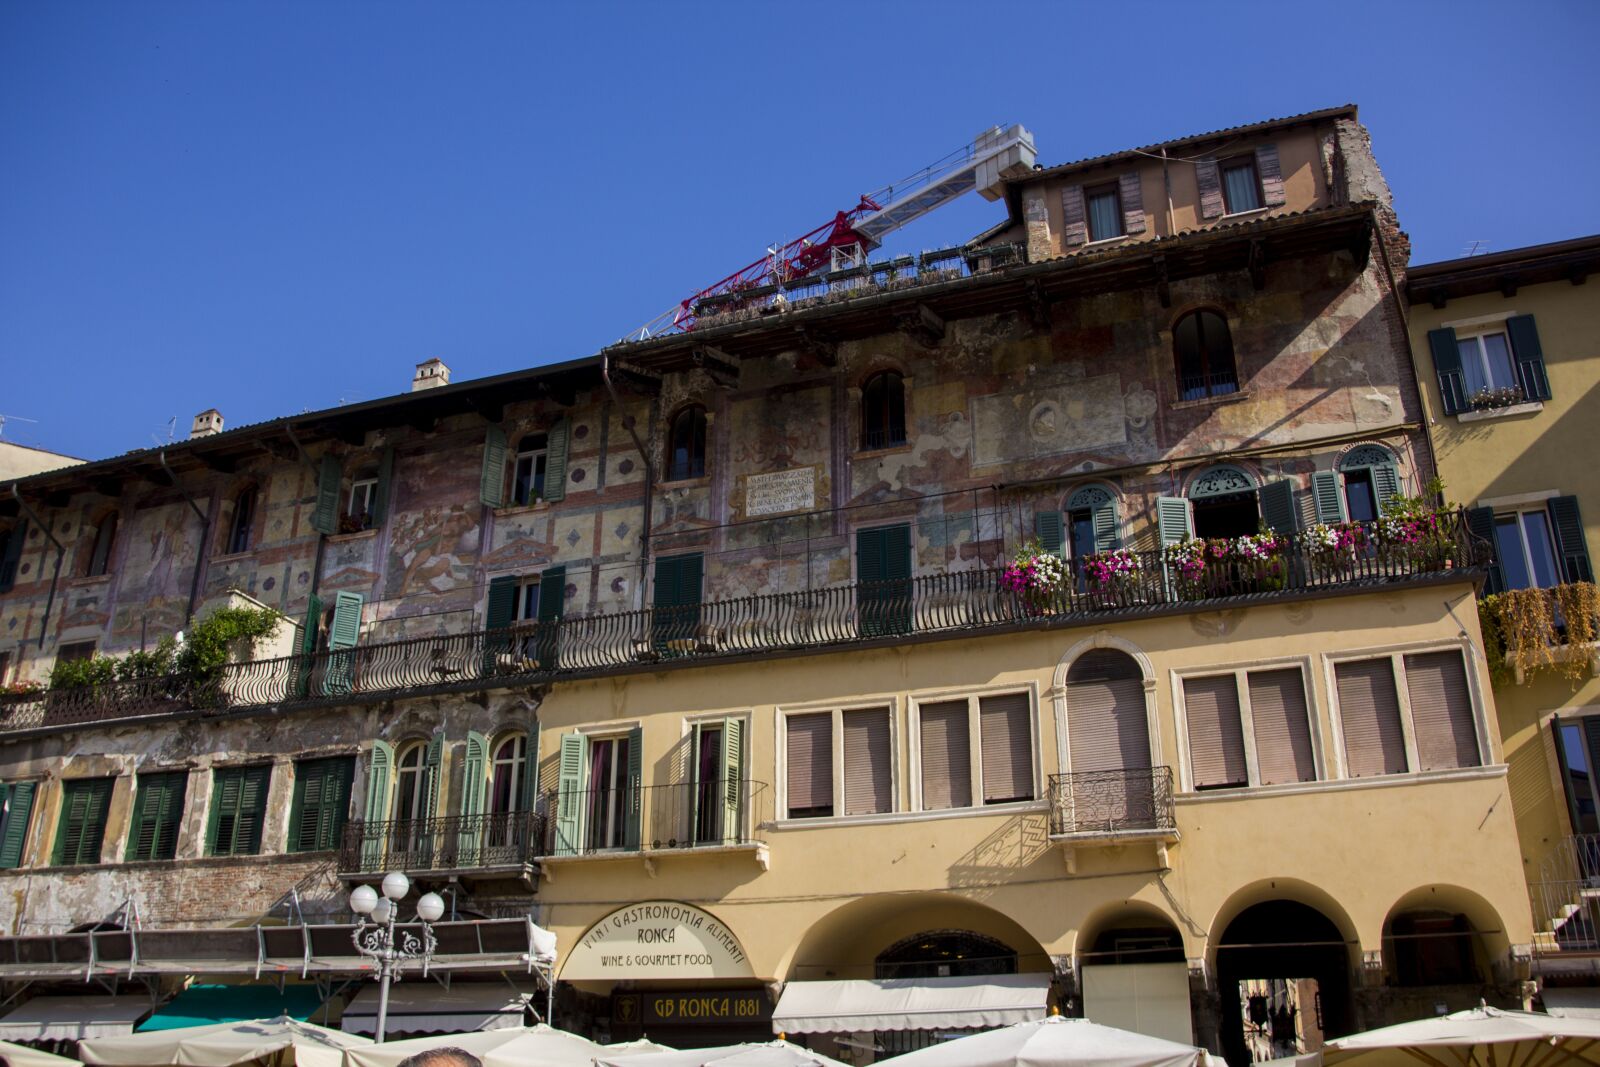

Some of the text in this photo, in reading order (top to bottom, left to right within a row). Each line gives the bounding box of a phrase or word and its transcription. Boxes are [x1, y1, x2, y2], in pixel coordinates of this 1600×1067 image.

[584, 906, 744, 964] VINI GASTRONOMIA ALIMENTI
[638, 928, 675, 944] RONCA
[601, 954, 712, 967] WINE & GOURMET FOOD
[655, 999, 759, 1017] GB RONCA 1881
